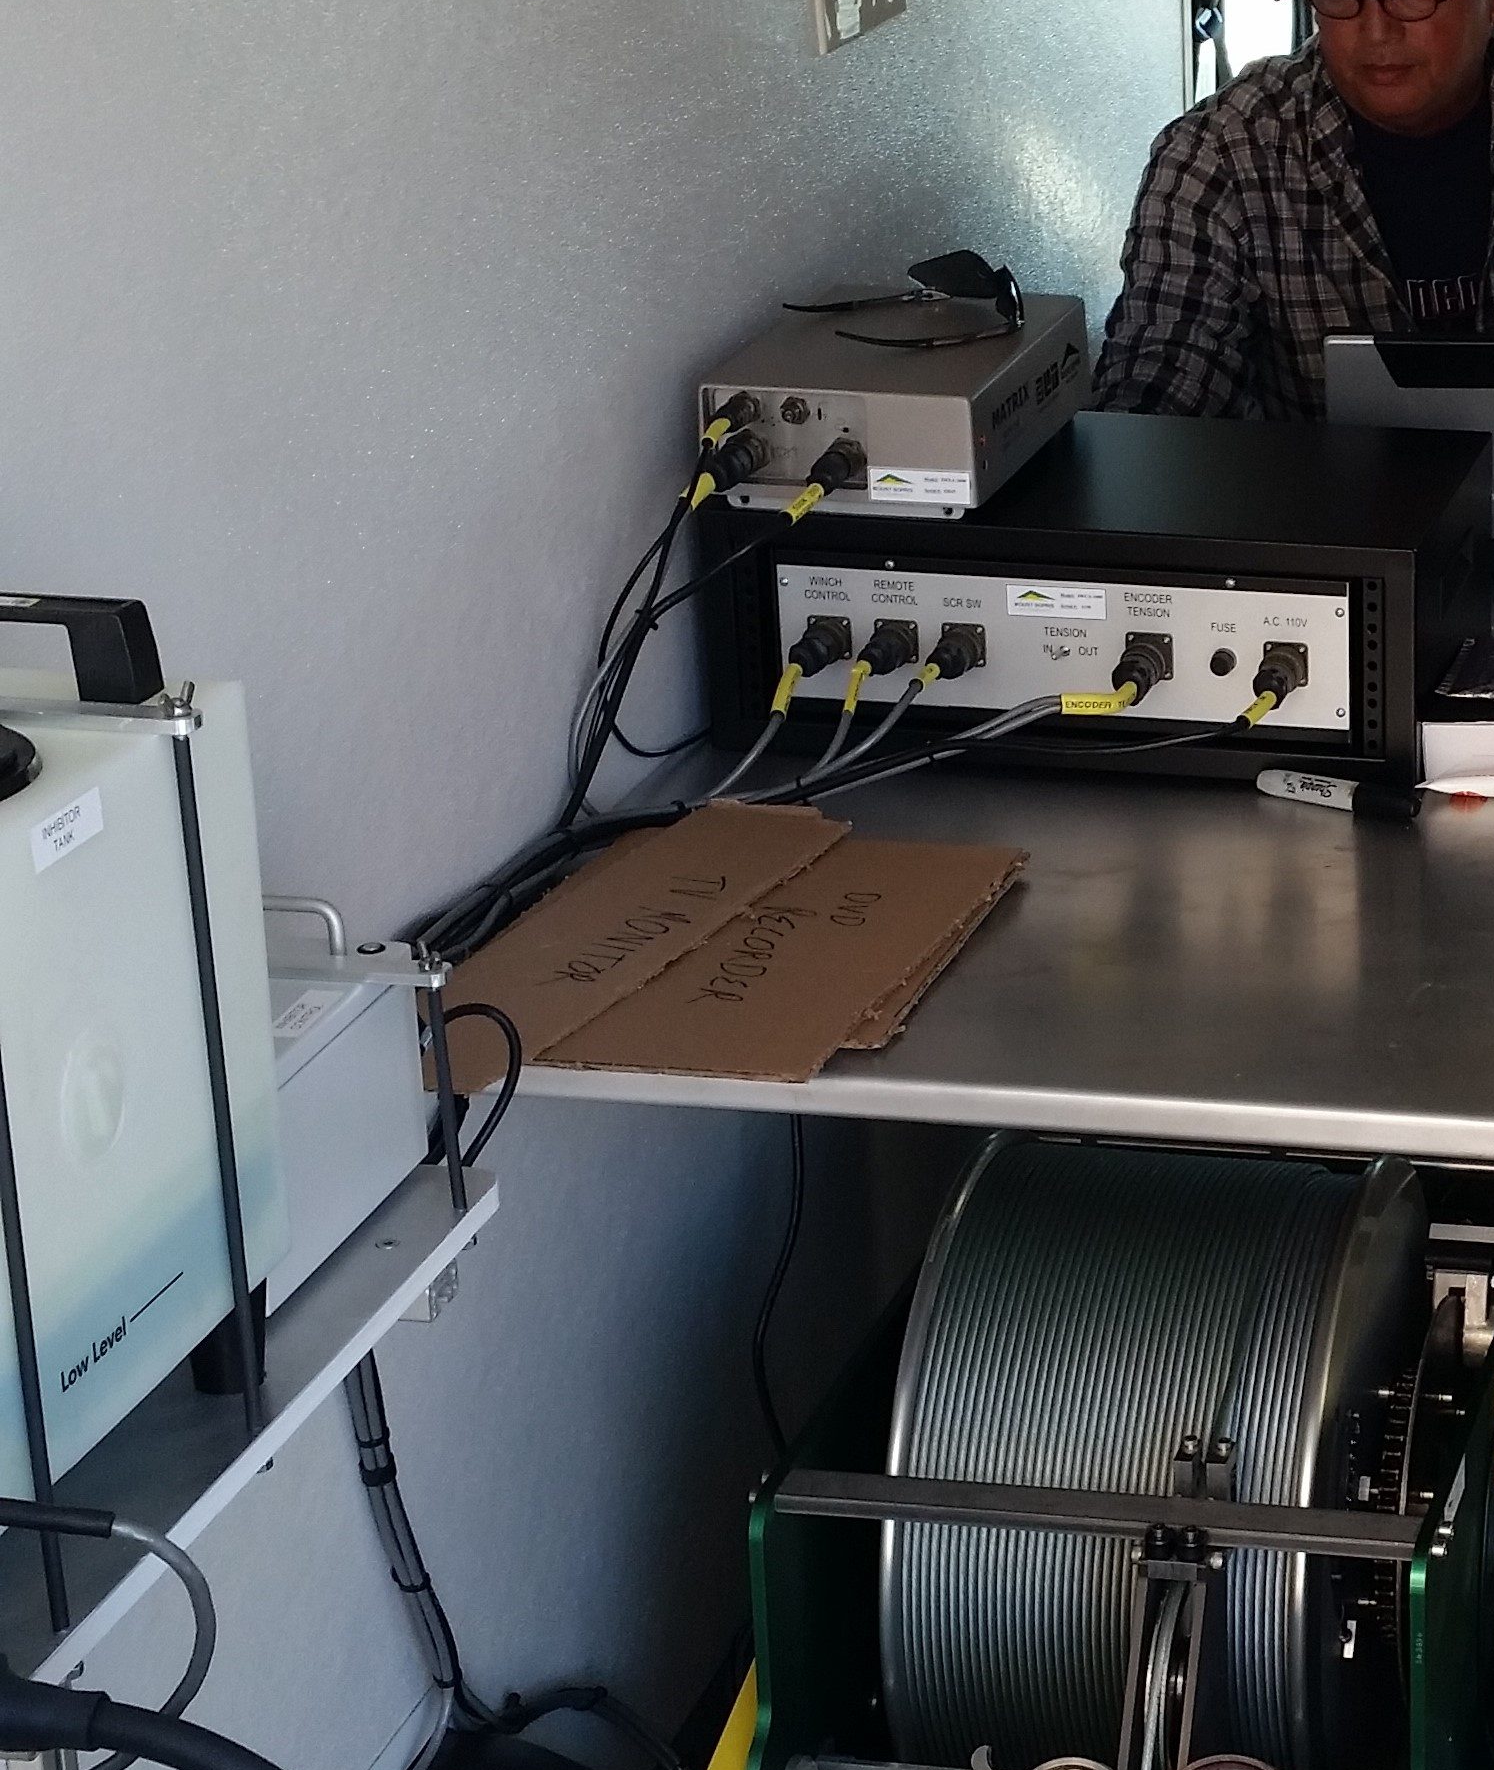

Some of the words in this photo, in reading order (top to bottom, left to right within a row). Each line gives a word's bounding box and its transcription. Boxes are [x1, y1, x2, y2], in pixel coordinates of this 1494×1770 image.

[992, 382, 1030, 430] MATRIX
[809, 576, 842, 588] WINCH
[873, 579, 914, 592] REMOTE
[804, 589, 851, 602] CONTROL
[871, 593, 918, 606] CONTROL
[1124, 592, 1173, 604] ENCODER
[943, 597, 963, 609] SCR
[965, 598, 982, 609] SW
[1127, 607, 1170, 618] TENSION
[1211, 622, 1237, 633] FUSE
[1286, 618, 1308, 628] 110V
[1044, 626, 1087, 638] TENSION
[1043, 645, 1053, 655] IN
[1078, 646, 1098, 657] OUT
[1065, 700, 1112, 709] ENCODER
[41, 806, 81, 839] INHIBITOR
[53, 831, 75, 851] TANK
[669, 875, 726, 901] TV
[830, 892, 882, 927] DVD
[535, 905, 692, 986] MONITOR
[687, 905, 818, 1004] RECORDER
[60, 1355, 90, 1393] Low
[92, 1315, 127, 1363] Level
